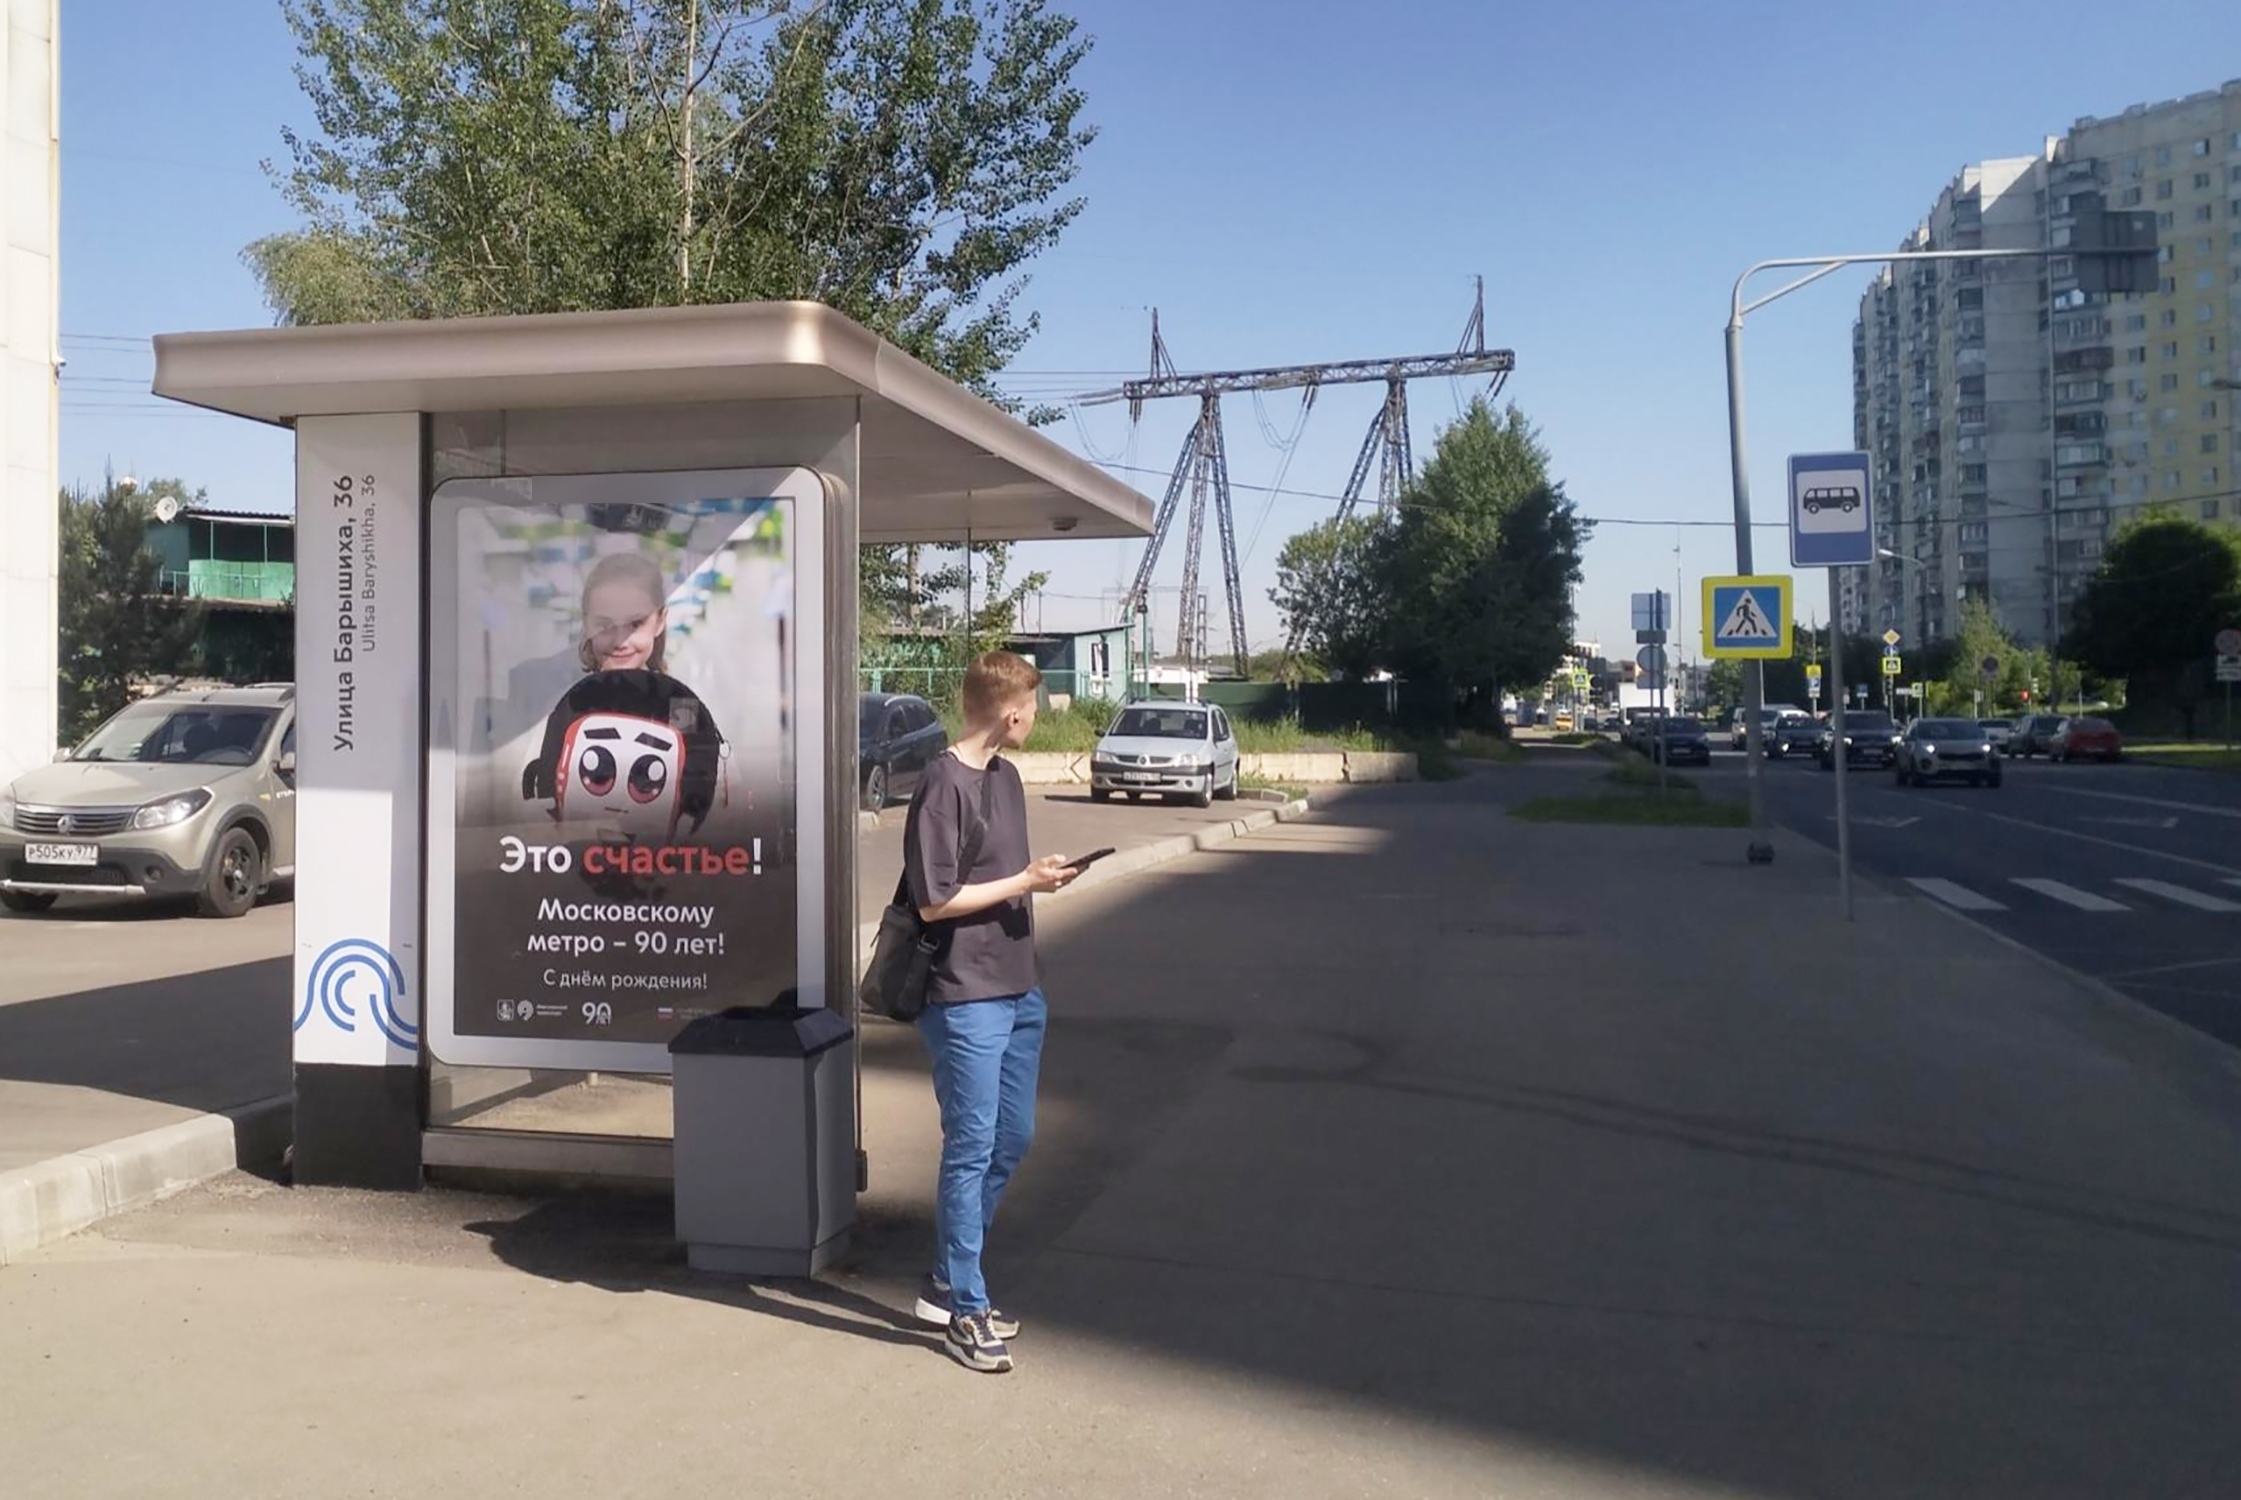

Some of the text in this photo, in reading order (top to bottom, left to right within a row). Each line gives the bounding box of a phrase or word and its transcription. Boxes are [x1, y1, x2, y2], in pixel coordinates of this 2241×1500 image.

[361, 474, 377, 653] Ulitsa Baryshikha, 36
[333, 475, 357, 751] Улица Барышиха, 36
[498, 835, 762, 875] Это счастье!
[537, 898, 715, 928] Московскому
[527, 932, 606, 957] метро
[634, 931, 668, 955] 90
[674, 932, 725, 955] лет!
[543, 969, 708, 990] С днём рождения!
